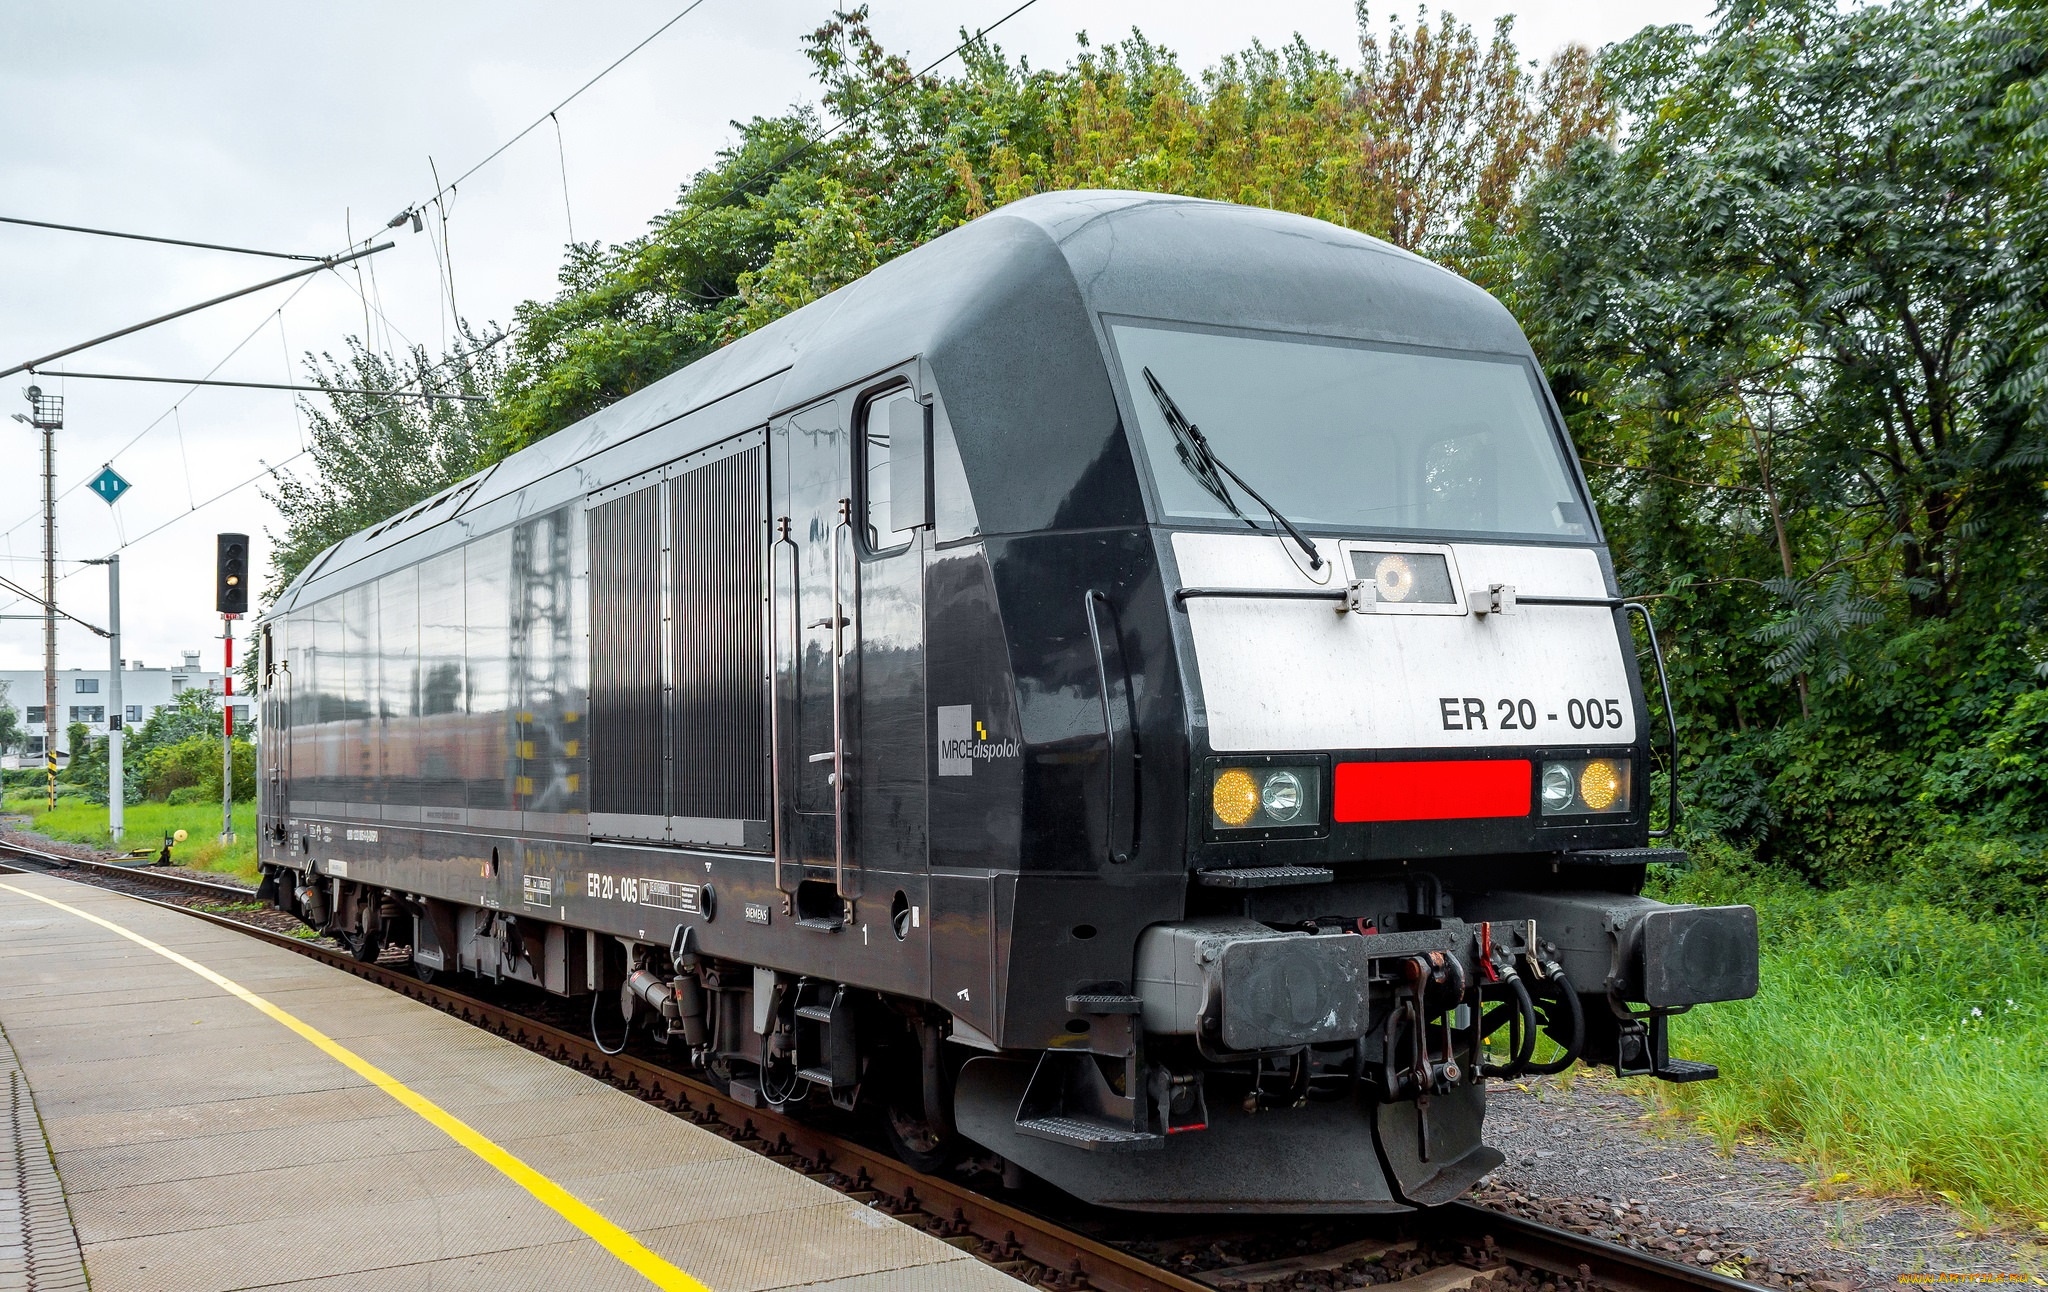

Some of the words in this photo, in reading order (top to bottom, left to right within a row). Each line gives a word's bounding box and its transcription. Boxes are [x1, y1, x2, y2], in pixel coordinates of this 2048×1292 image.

[1439, 697, 1488, 730] ER
[1497, 698, 1537, 730] 20
[1567, 698, 1623, 730] 005
[587, 872, 600, 898] ER
[601, 875, 613, 900] 20
[620, 877, 638, 904] 005
[745, 907, 767, 921] SIEMENS
[862, 923, 868, 946] 1
